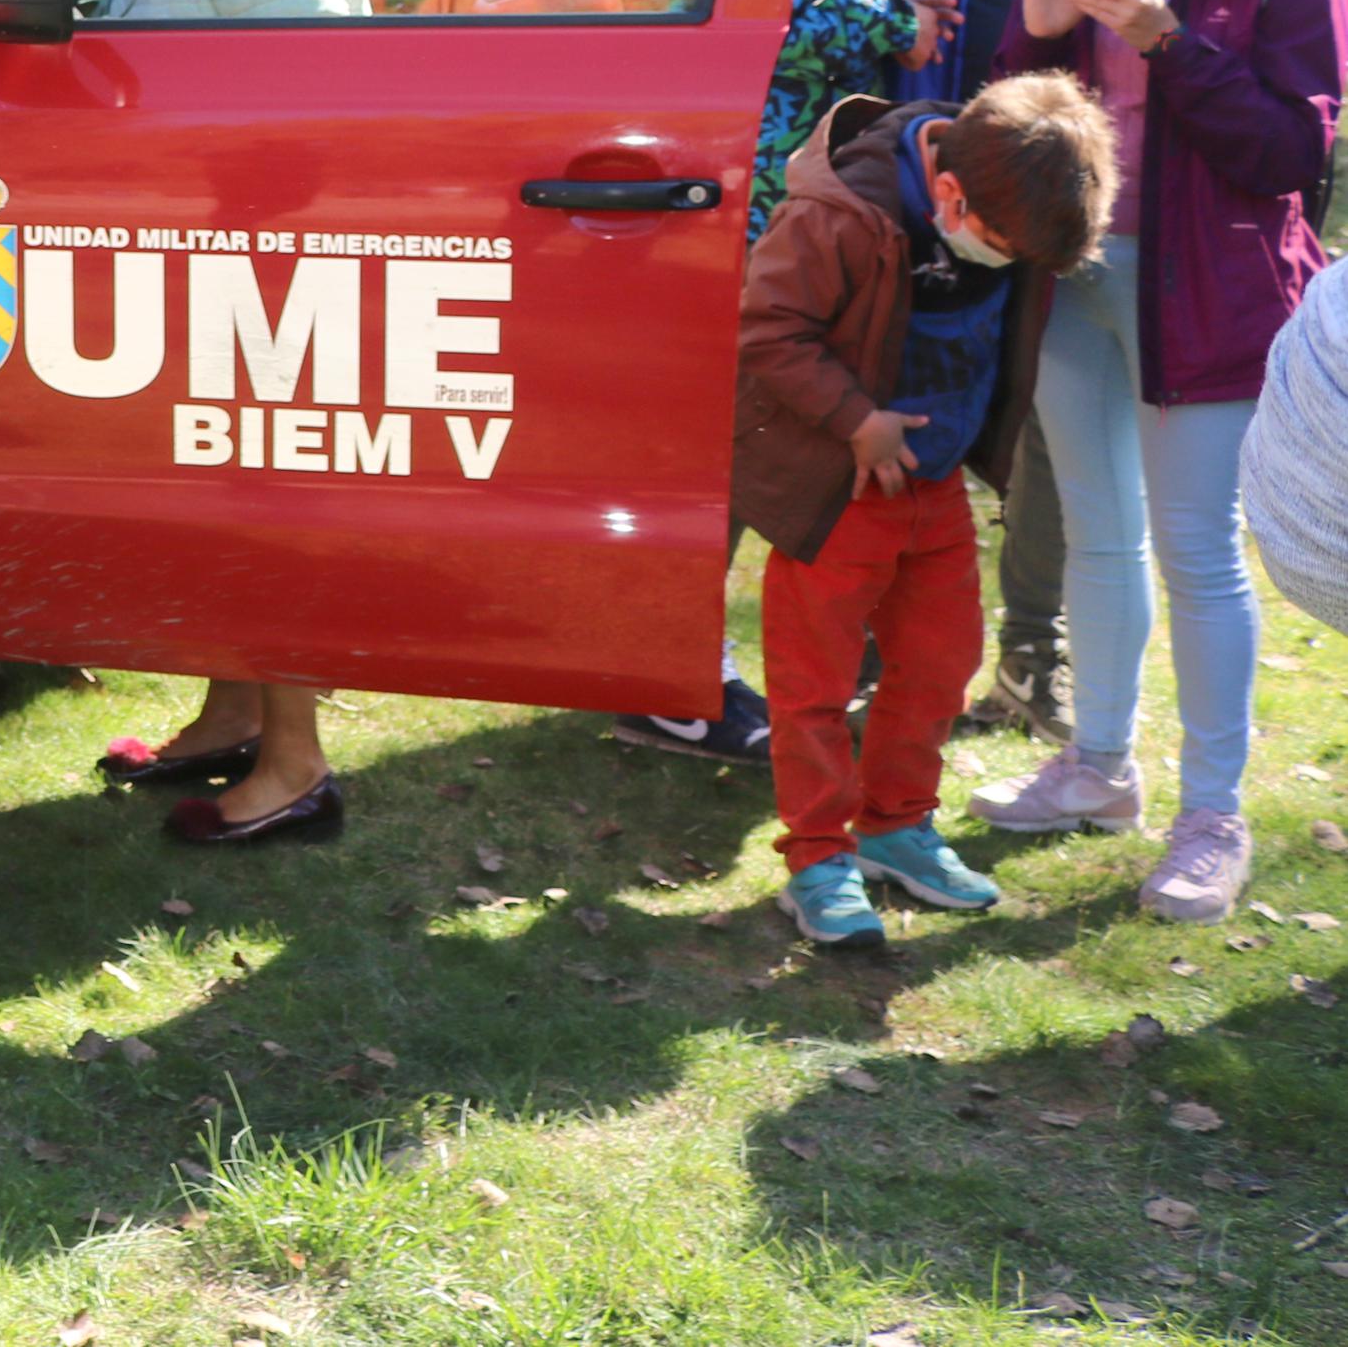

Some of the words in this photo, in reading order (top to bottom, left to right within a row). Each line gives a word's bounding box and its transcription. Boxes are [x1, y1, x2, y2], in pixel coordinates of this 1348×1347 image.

[23, 225, 130, 248] UNIDAD
[136, 228, 250, 252] MILITAR
[256, 231, 296, 253] DE
[303, 232, 513, 259] EMERGENCIAS
[23, 249, 514, 412] UME
[172, 403, 412, 477] BIEM
[445, 415, 513, 480] V
